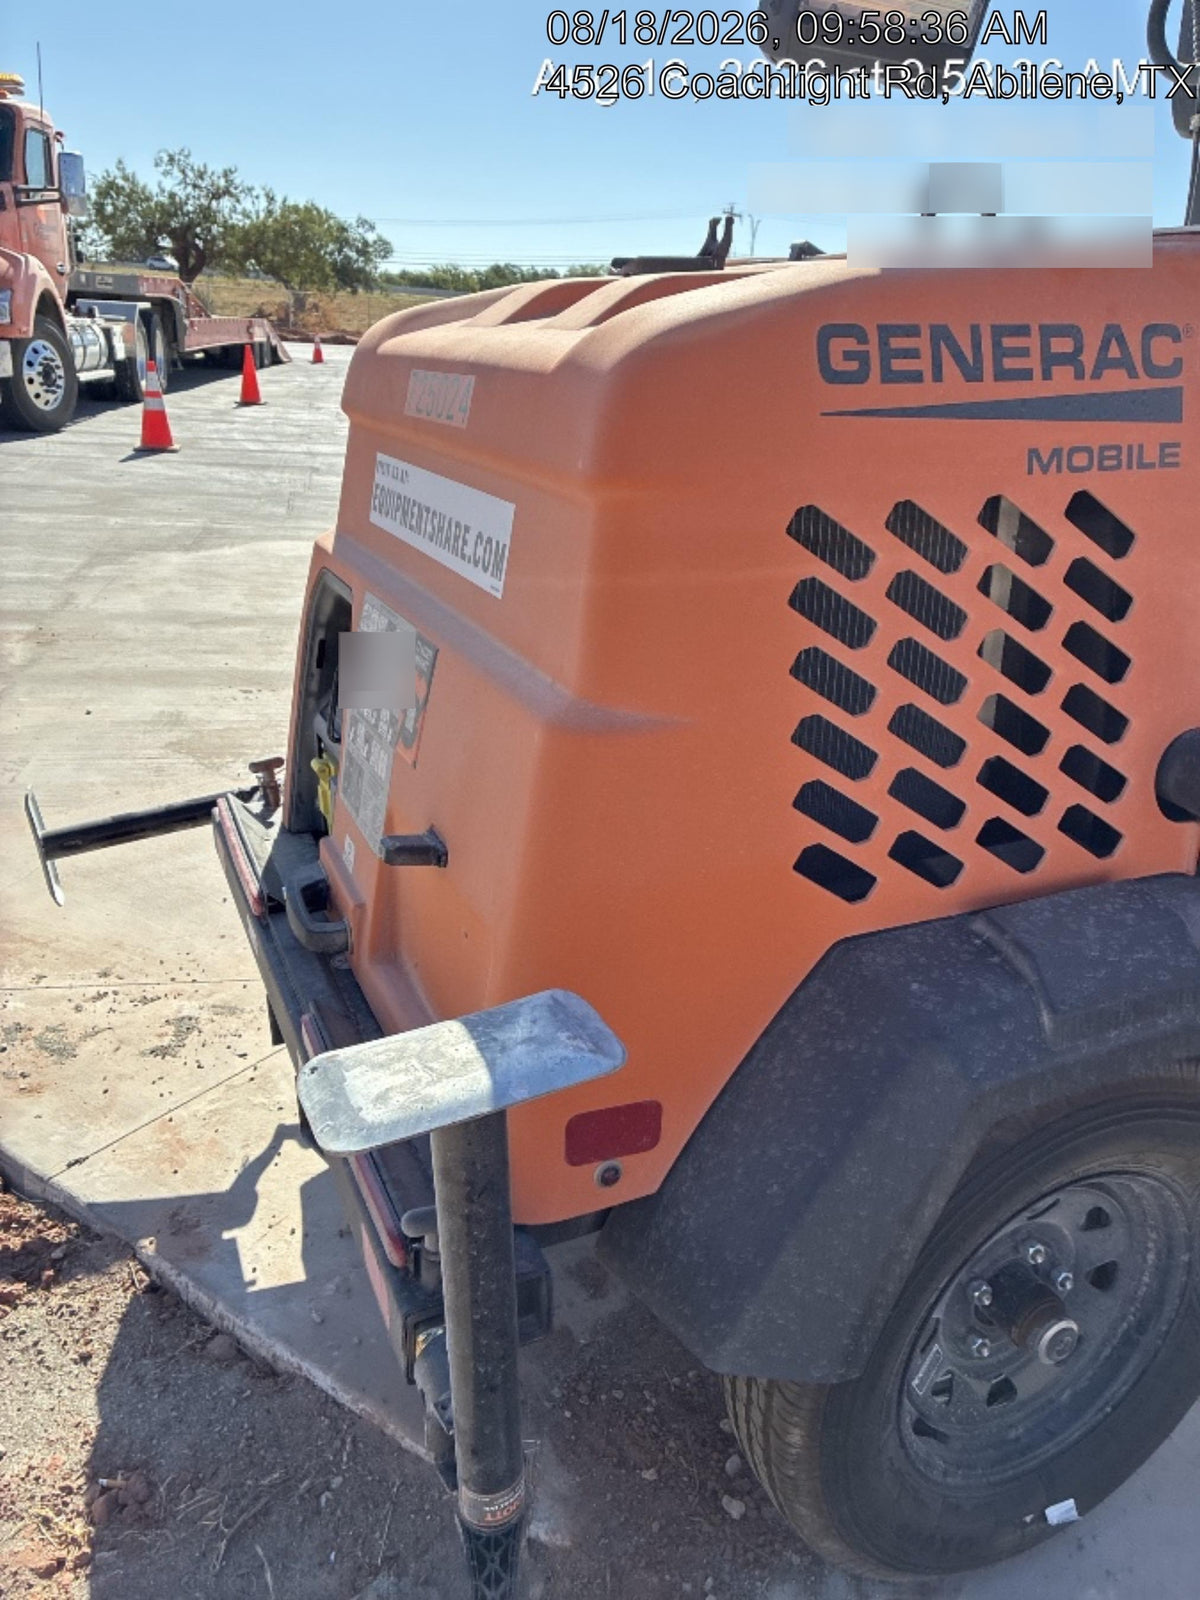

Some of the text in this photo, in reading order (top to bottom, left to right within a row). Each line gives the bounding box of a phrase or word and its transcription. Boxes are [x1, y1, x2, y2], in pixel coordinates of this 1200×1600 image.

[816, 322, 1184, 385] GENERAC
[1027, 442, 1182, 475] MOBILE
[372, 483, 508, 583] EQUIPMENTSHARE.COM
